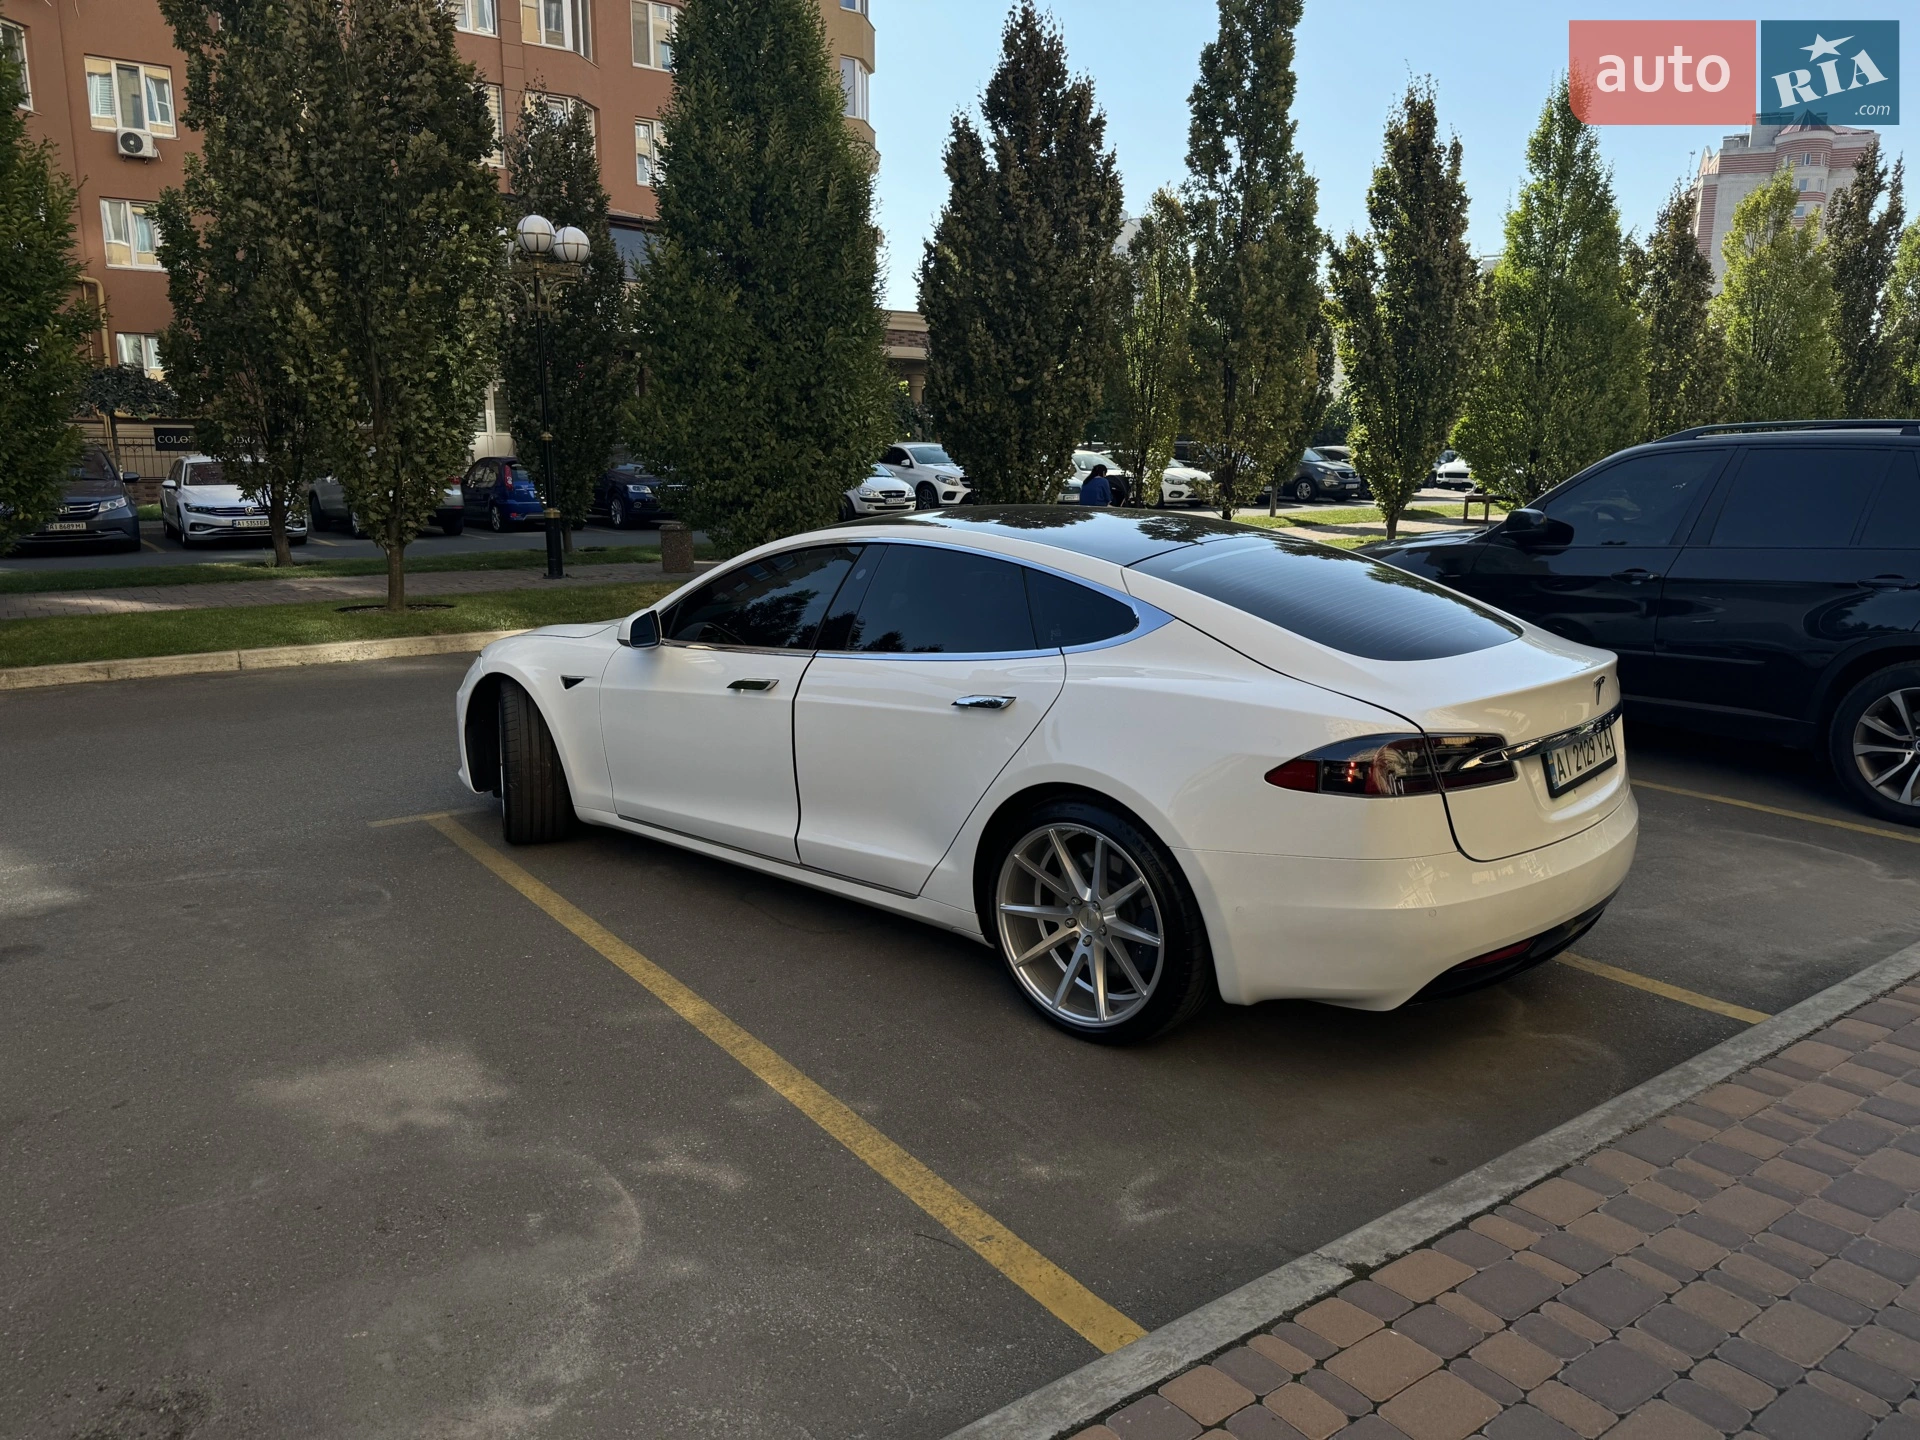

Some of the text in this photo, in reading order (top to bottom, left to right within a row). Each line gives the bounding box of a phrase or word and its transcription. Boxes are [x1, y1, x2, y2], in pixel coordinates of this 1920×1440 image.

[1556, 730, 1612, 782] AI 2129 YA
